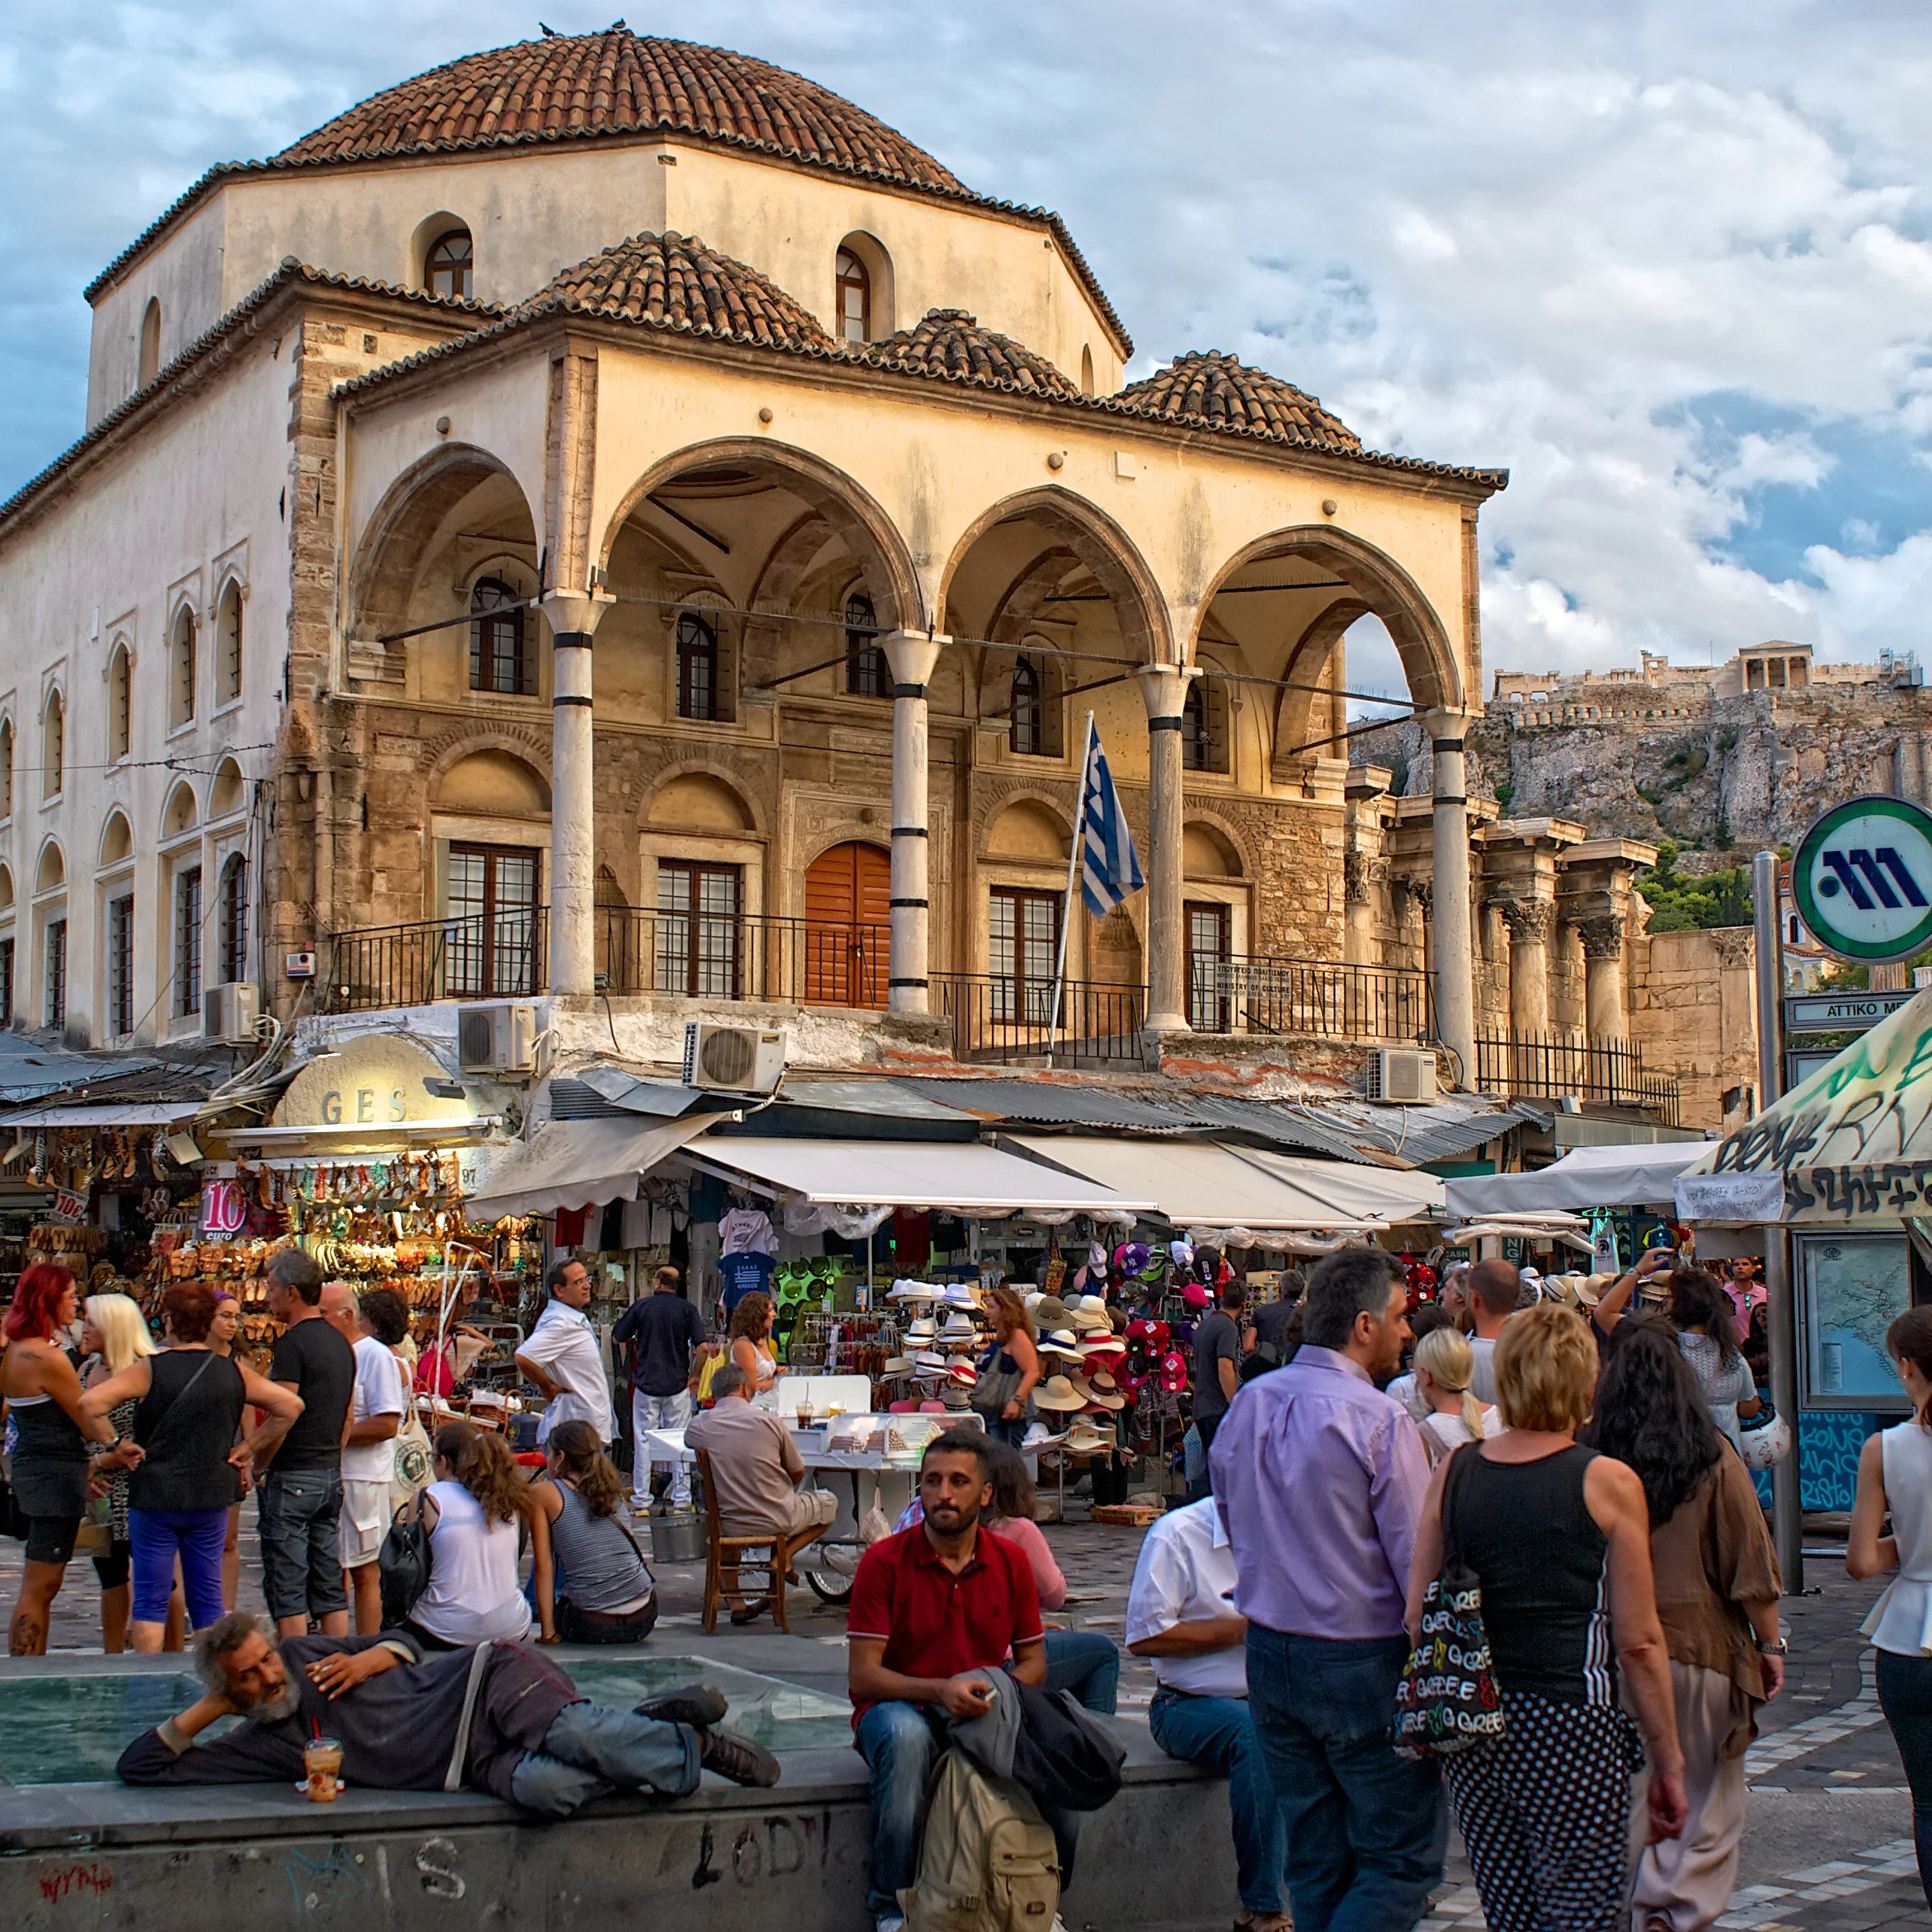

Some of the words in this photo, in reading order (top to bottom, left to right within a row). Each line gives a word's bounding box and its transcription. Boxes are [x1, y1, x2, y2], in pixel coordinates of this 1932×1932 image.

[1217, 982, 1247, 990] MINISTRY
[1262, 985, 1290, 993] CULTURE
[321, 1087, 407, 1125] GES
[462, 1168, 477, 1184] 97
[57, 1195, 83, 1219] 10€
[204, 1182, 246, 1231] 10
[731, 1222, 754, 1232] ATHENS
[206, 1231, 233, 1241] euro
[1445, 1250, 1469, 1258] CASH
